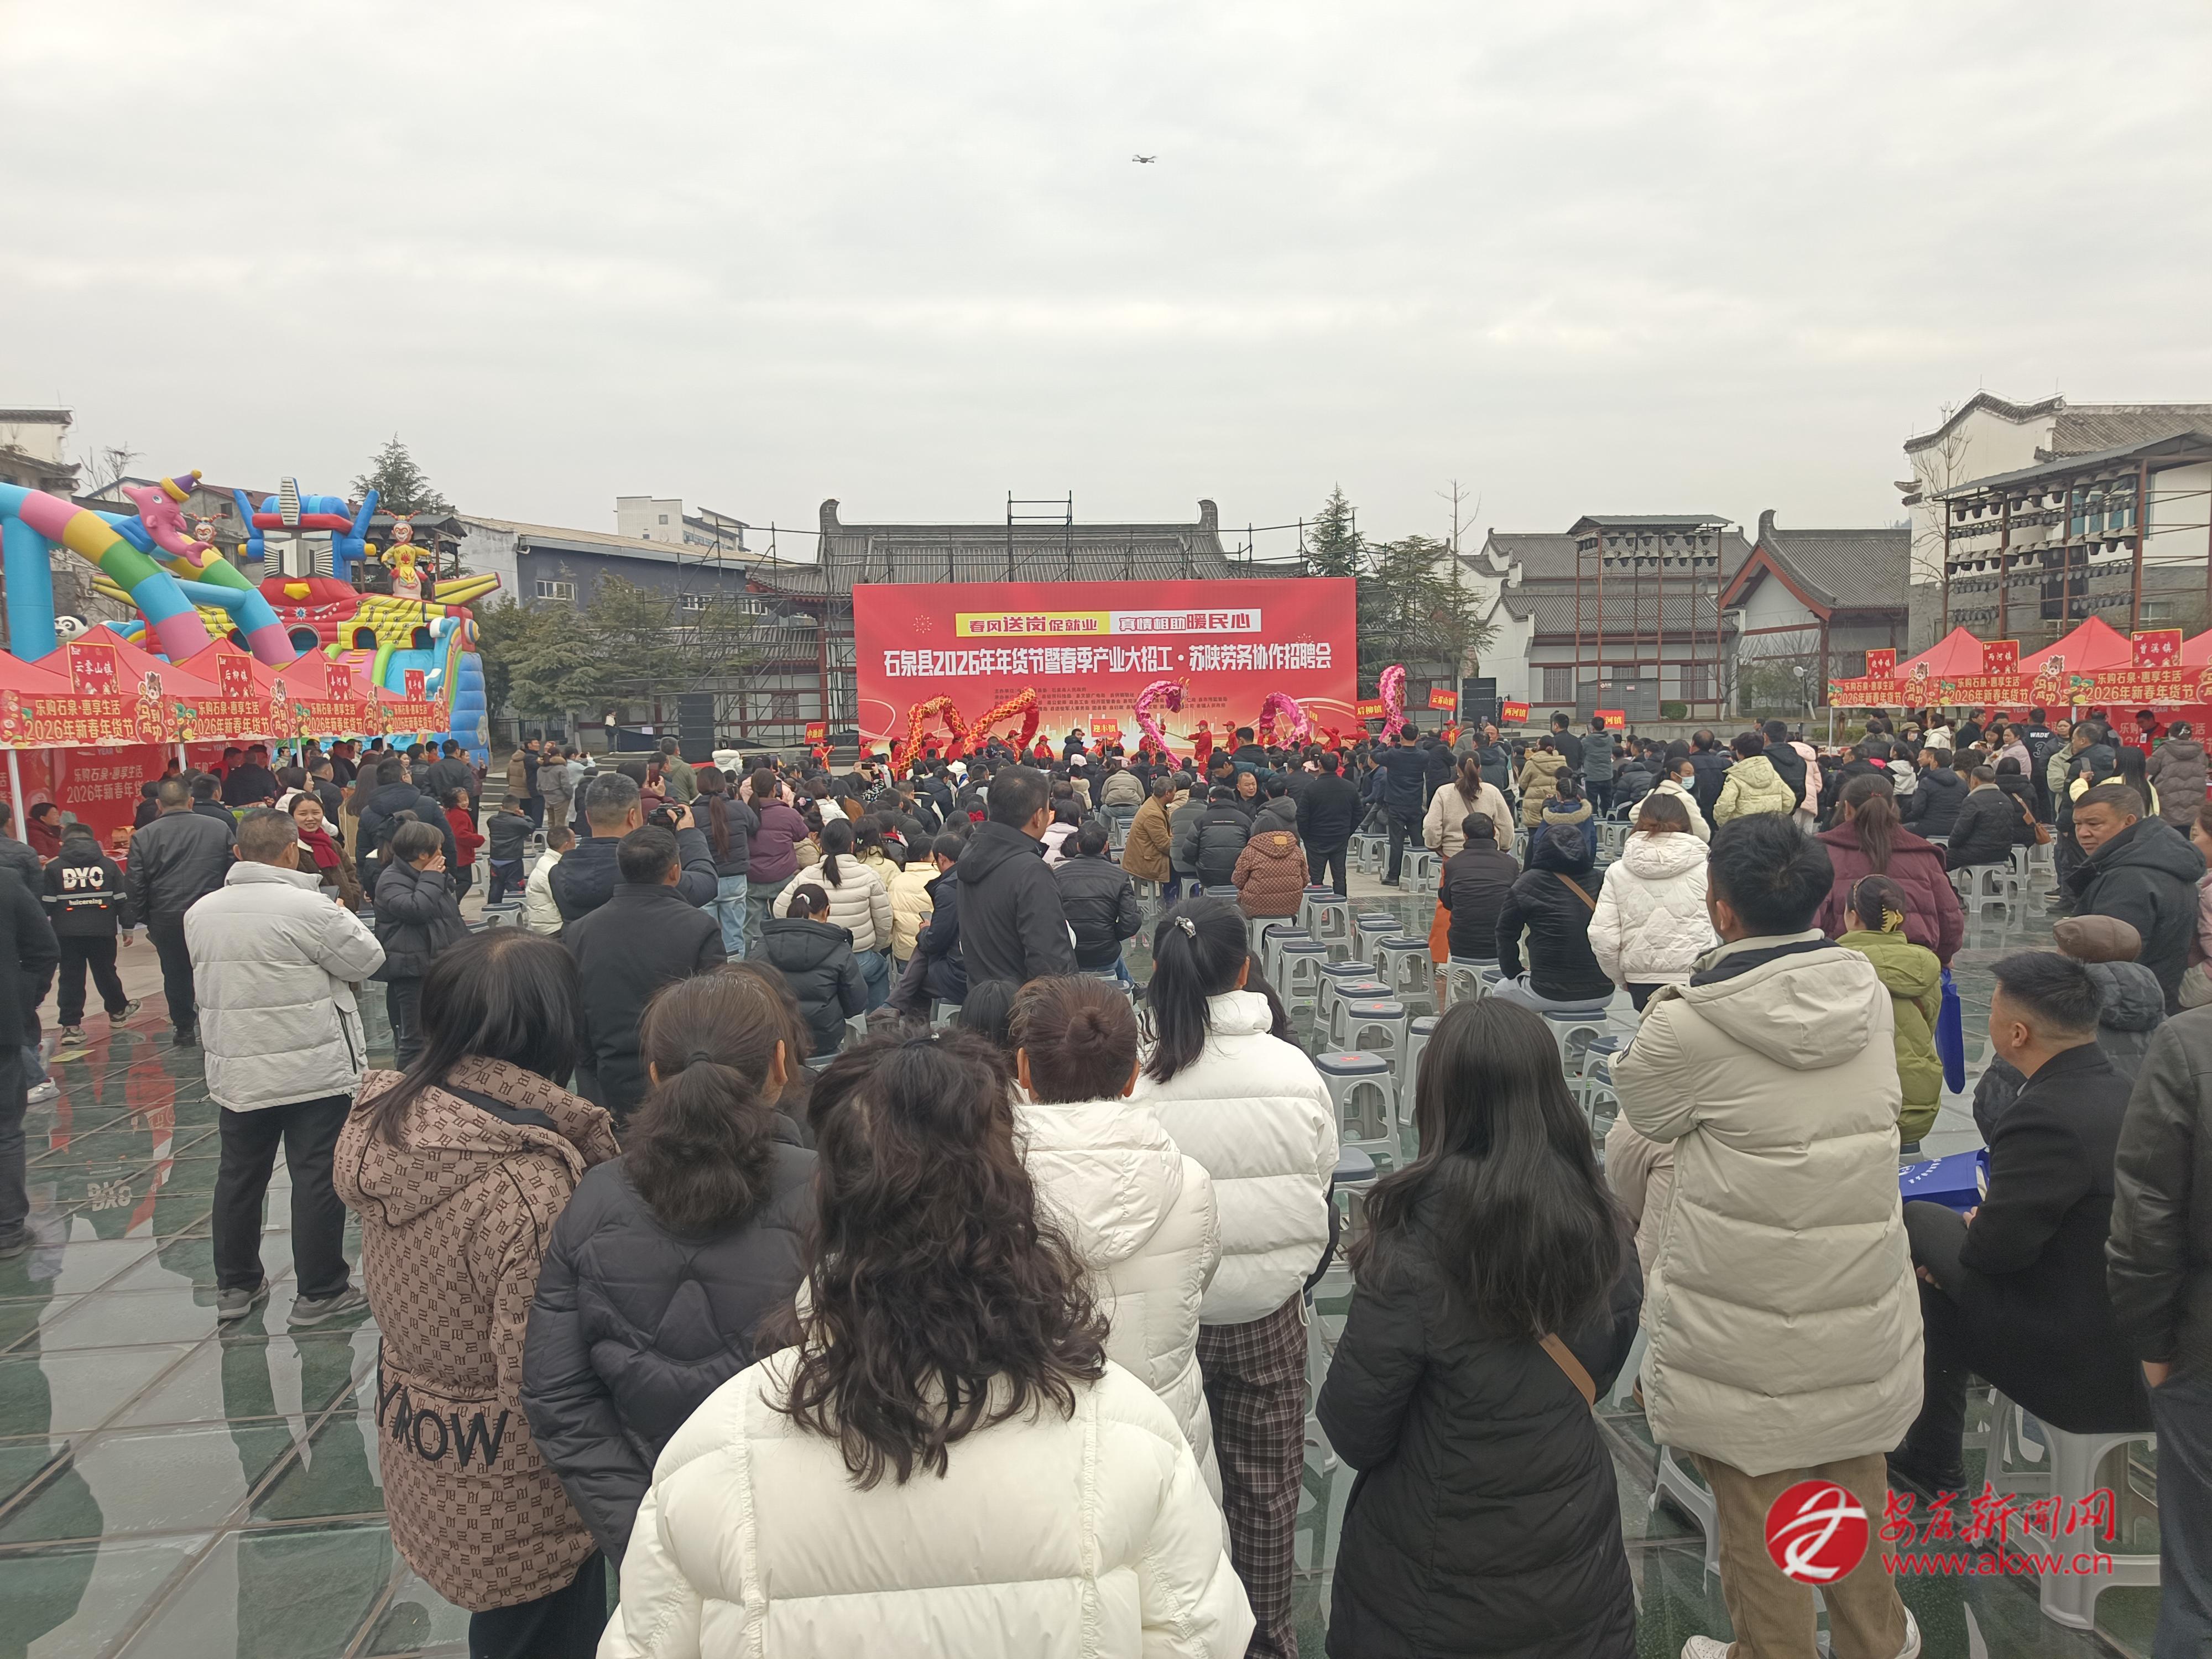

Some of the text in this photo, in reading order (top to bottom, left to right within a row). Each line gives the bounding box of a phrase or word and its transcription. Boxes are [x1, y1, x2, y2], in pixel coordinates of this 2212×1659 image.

[969, 613, 1250, 633] 春风送岗促就业 真情相助暖民心
[2140, 641, 2173, 654] 曾溪镇
[884, 642, 1332, 677] 石泉县2026年年货节暨春季产业大招工·苏陕劳务协作招聘会
[1988, 651, 2012, 661] 两河镇
[225, 668, 248, 682] 后柳镇
[2098, 670, 2183, 685] 乐购石泉·惠享生活
[1949, 688, 2029, 702] 2026年新春年货节
[2085, 684, 2195, 701] 2026年新春年货节
[1357, 705, 1383, 715] 后柳镇
[1504, 707, 1527, 718] 两河镇
[191, 717, 270, 735] 2026年新春年货节
[1605, 716, 1623, 725] 河镇
[25, 718, 134, 740] 2026年新春年货节
